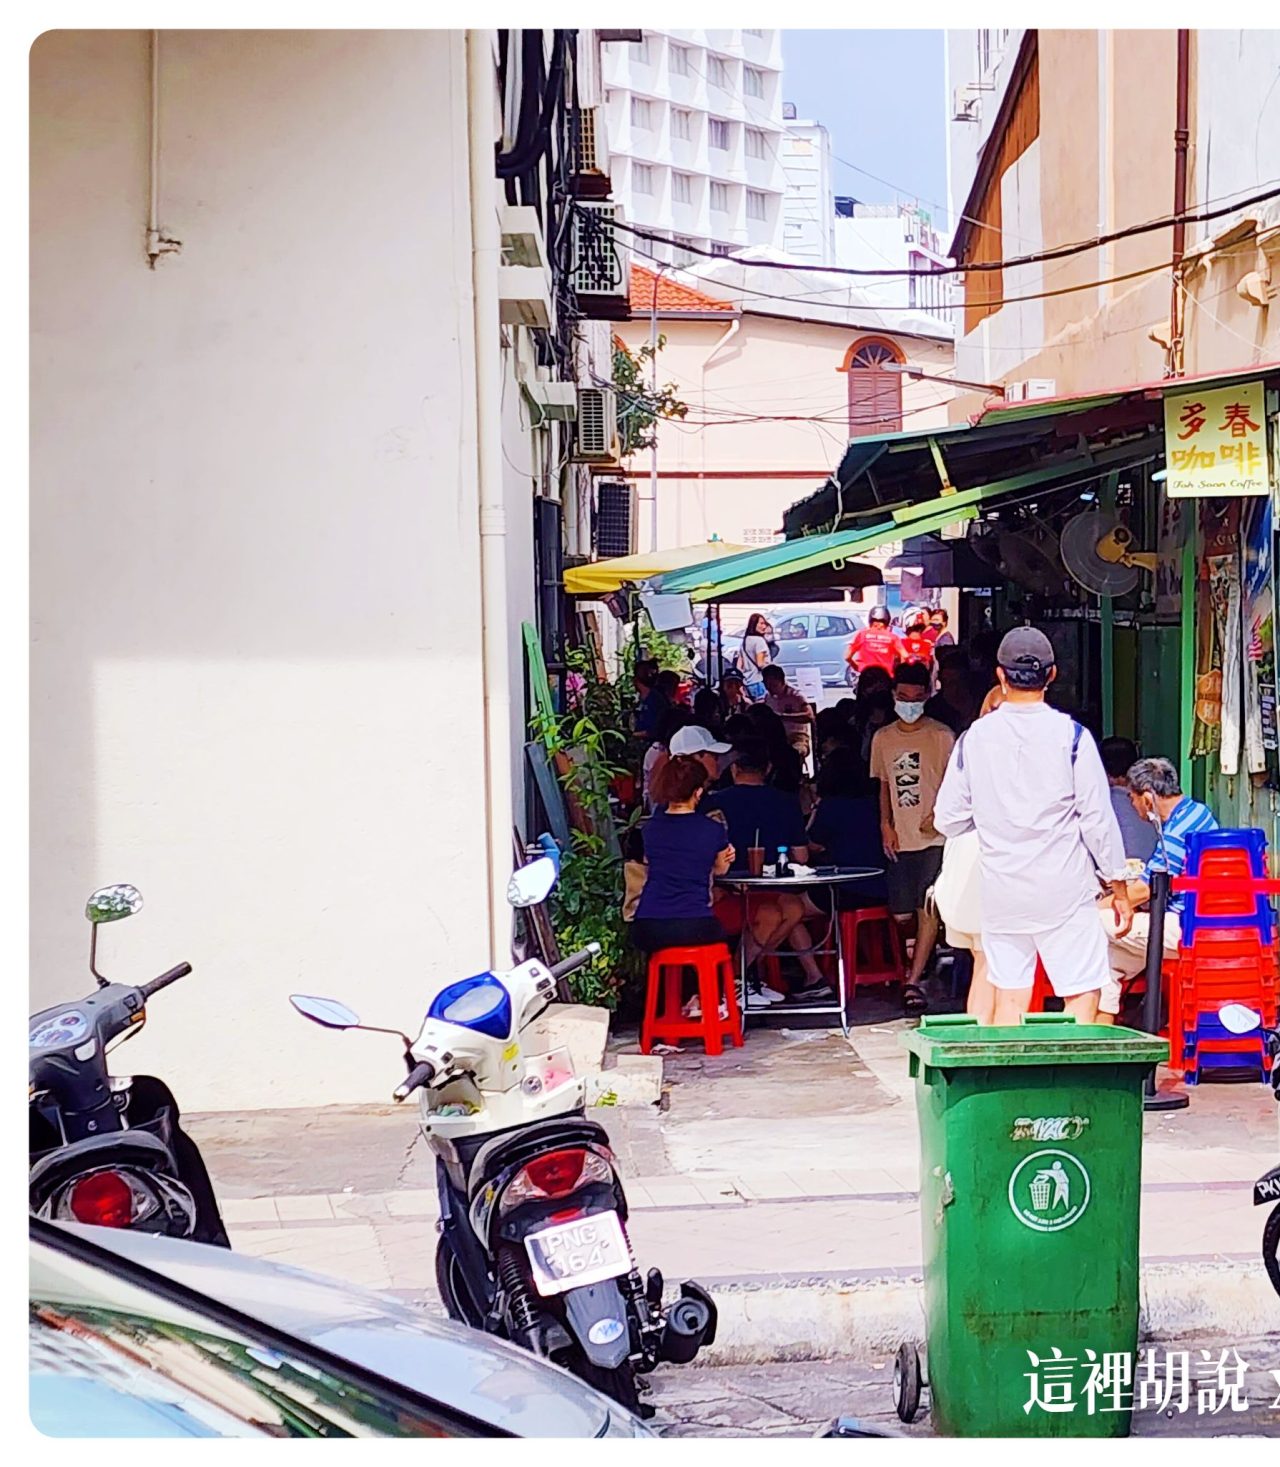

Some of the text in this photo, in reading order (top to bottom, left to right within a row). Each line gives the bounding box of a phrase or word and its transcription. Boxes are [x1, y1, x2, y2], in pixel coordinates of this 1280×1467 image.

[1177, 402, 1260, 440] 多春
[1171, 441, 1262, 476] 咖啡
[1230, 479, 1263, 489] Coffee
[546, 1225, 598, 1255] PNG
